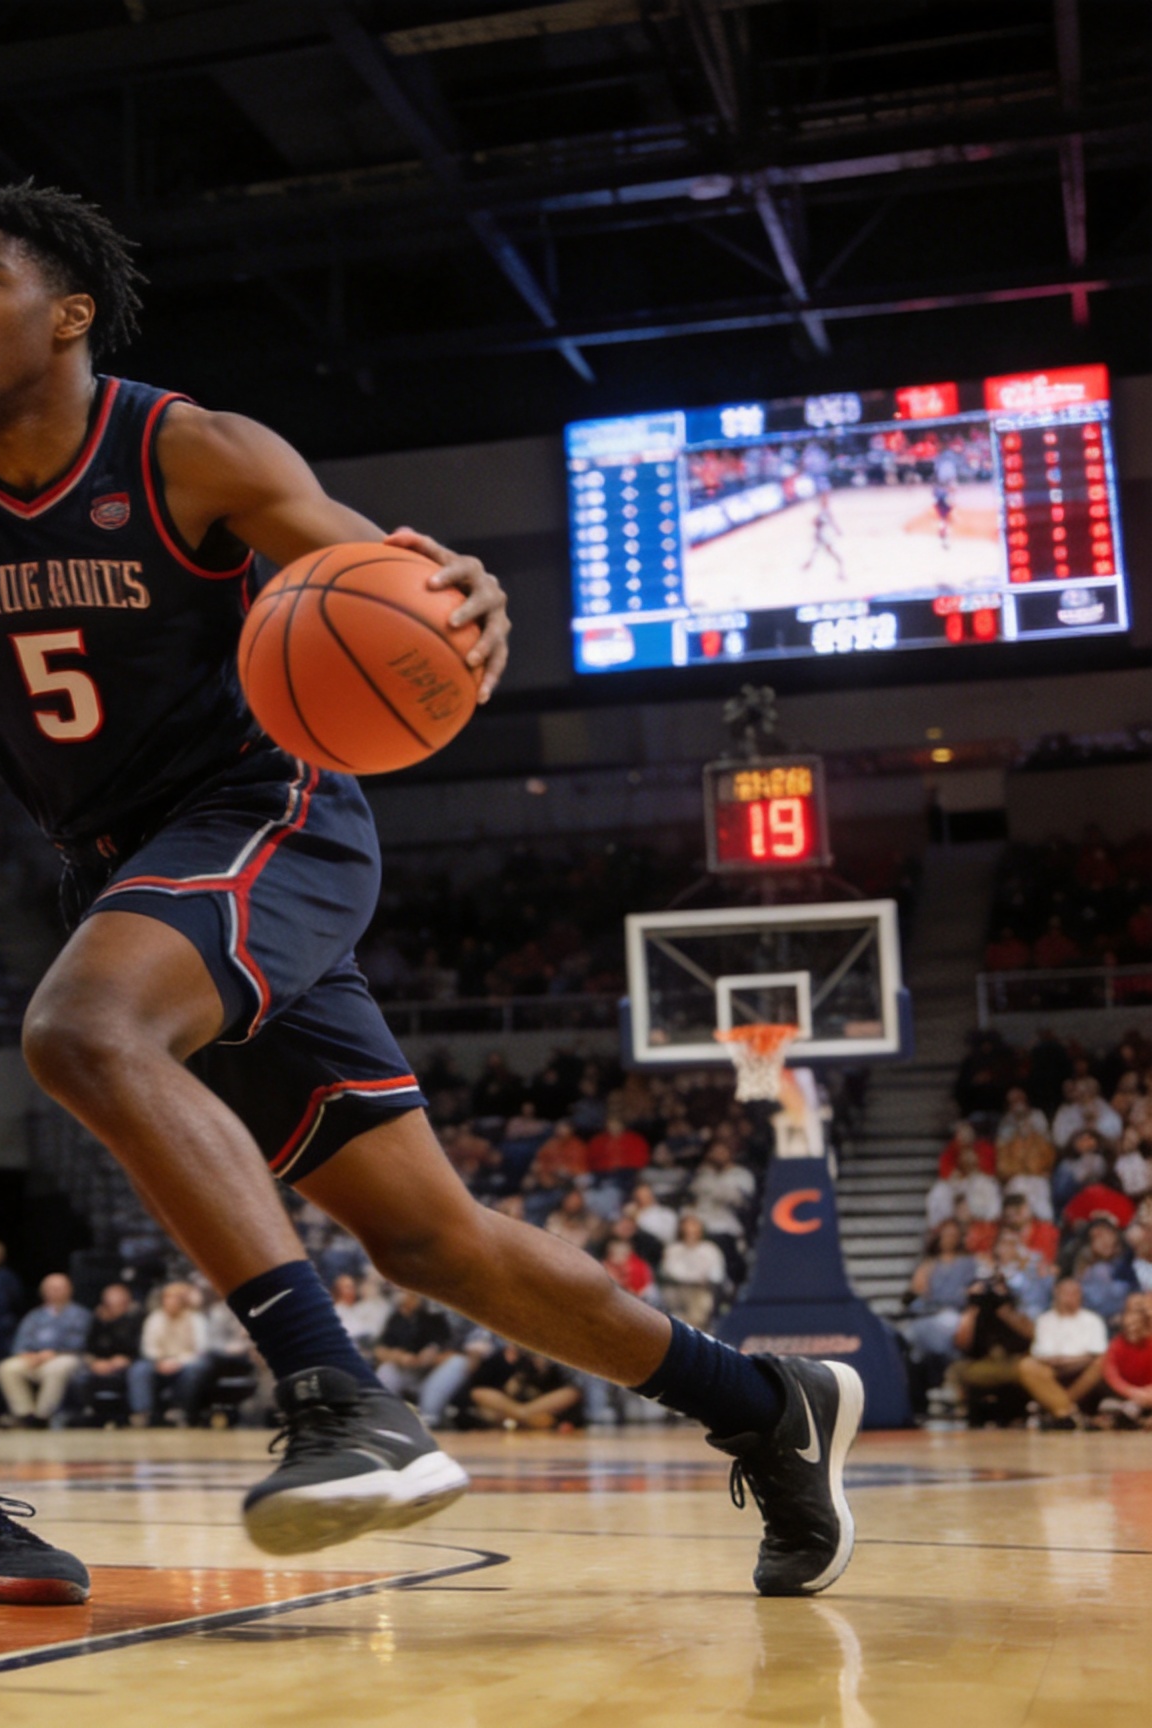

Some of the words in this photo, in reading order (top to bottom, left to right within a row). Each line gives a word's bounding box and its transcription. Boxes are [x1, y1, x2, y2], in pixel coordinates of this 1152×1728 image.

[8, 628, 105, 743] 5
[750, 798, 805, 857] 19
[771, 1188, 822, 1235] C
